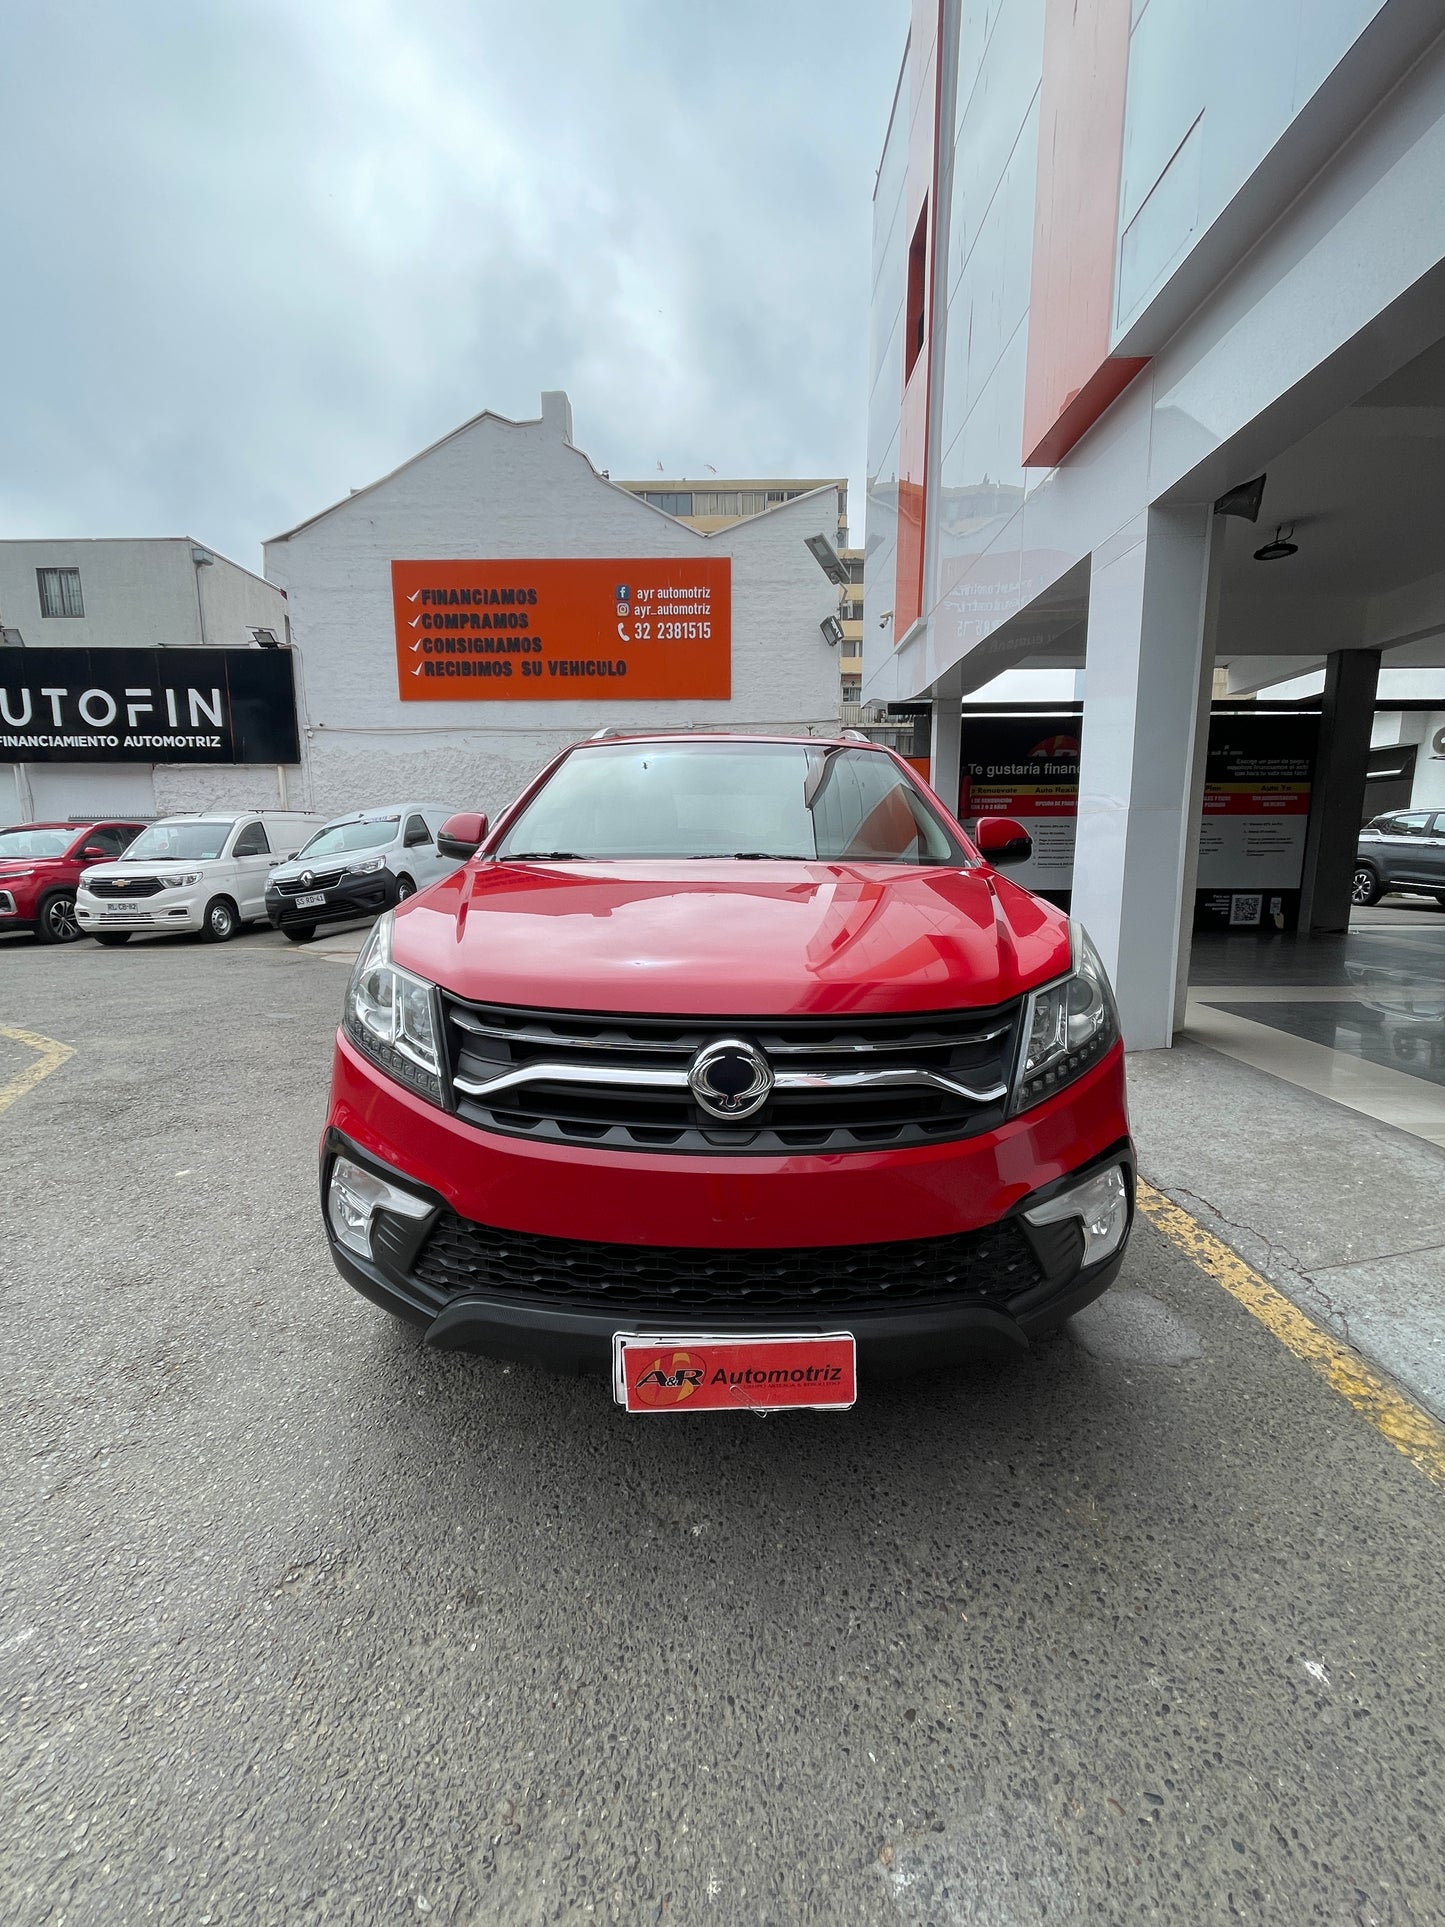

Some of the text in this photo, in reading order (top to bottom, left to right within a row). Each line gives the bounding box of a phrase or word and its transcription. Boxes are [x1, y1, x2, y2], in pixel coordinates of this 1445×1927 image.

[421, 588, 538, 605] FINANCIAMOS
[637, 587, 711, 602] ayr automotriz
[634, 603, 711, 618] ayr_automotriz
[422, 613, 529, 629] COMPRAMOS
[635, 622, 711, 639] 32 2381515
[422, 637, 542, 653] CONSIGNAMOS
[424, 660, 627, 677] RECIBIMOS SU VEHICULO
[124, 735, 221, 747] AUTOMOTRIZ
[968, 763, 983, 775] Te
[986, 762, 1040, 777] gustaría
[635, 1364, 842, 1388] A&R Automotriz
